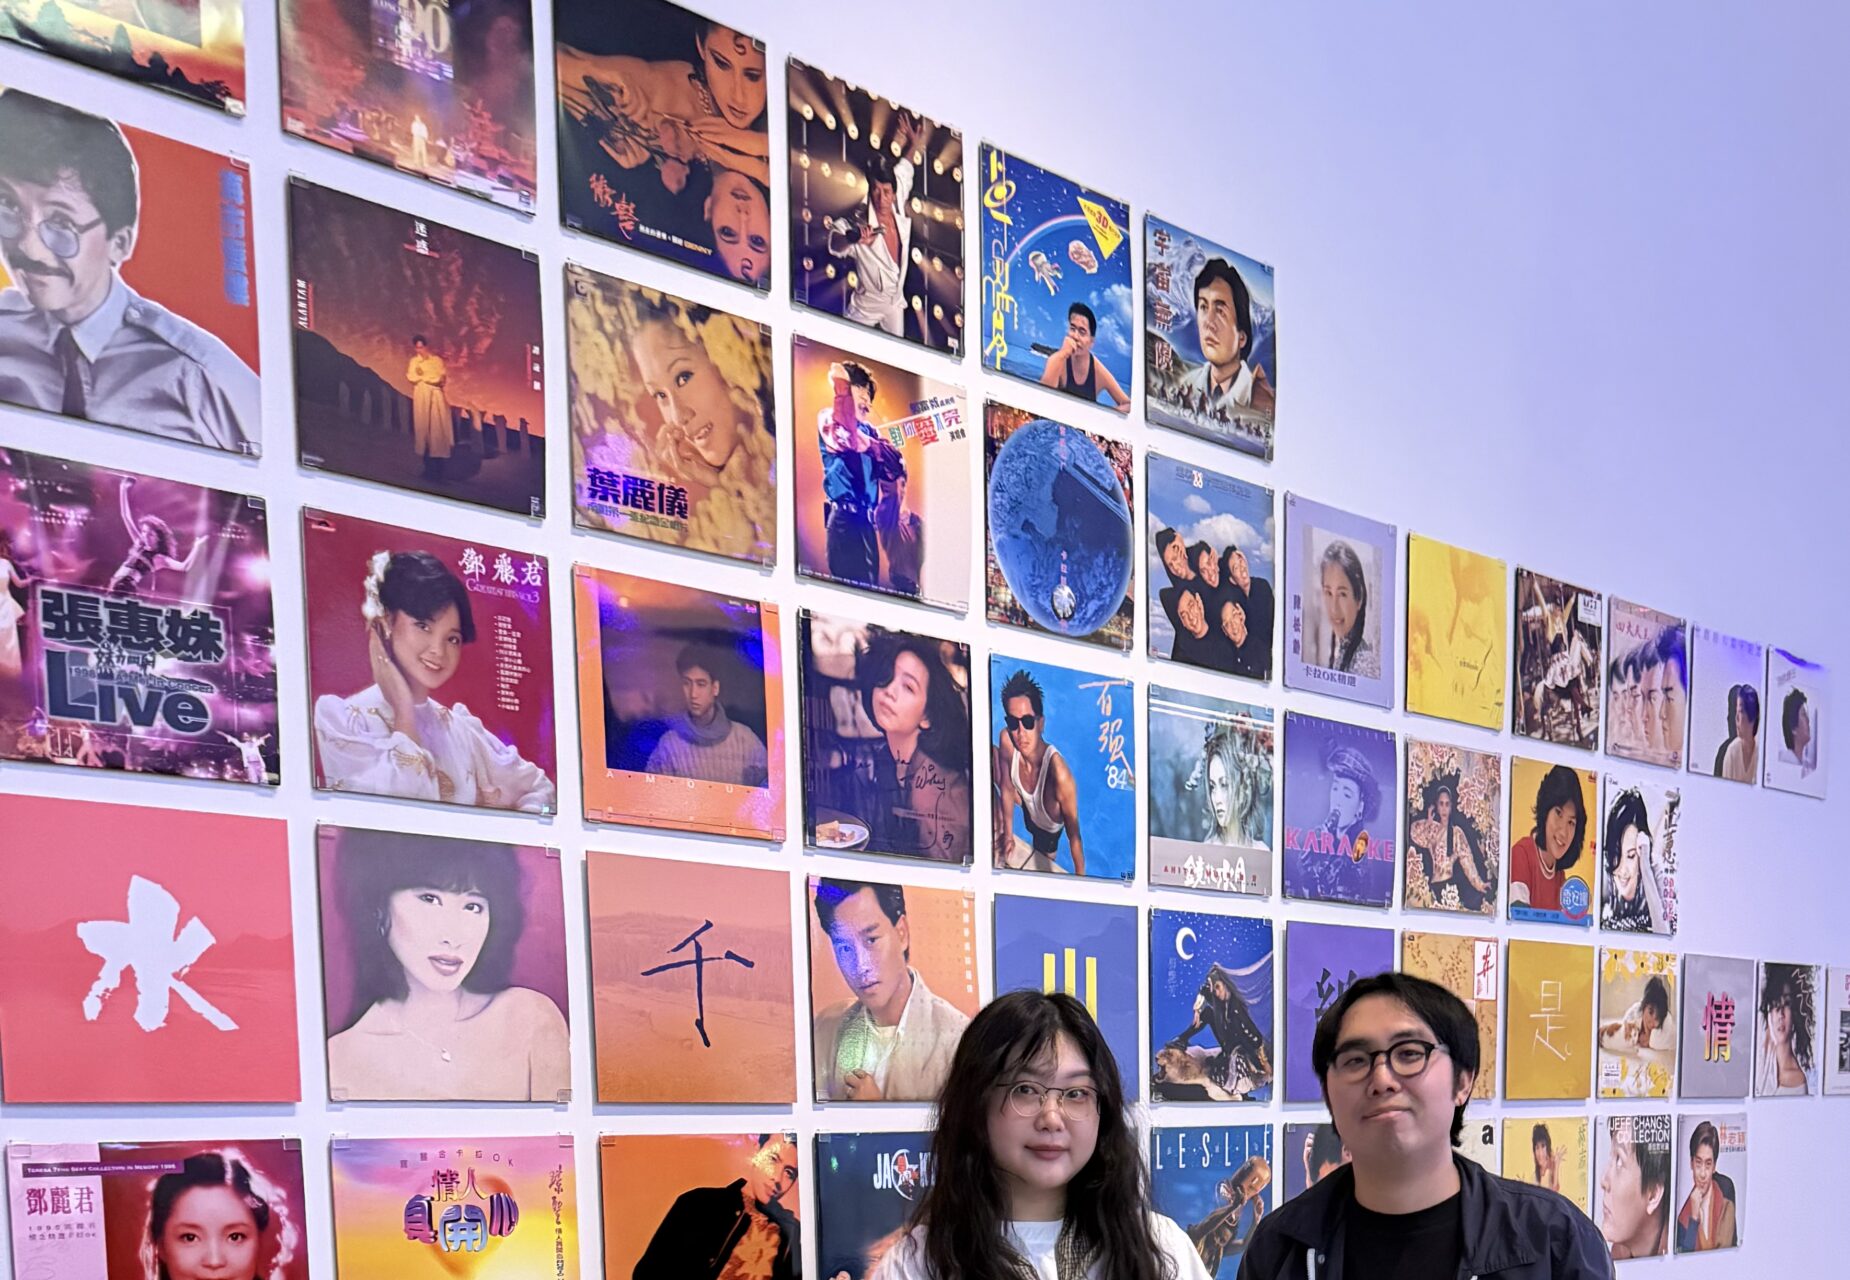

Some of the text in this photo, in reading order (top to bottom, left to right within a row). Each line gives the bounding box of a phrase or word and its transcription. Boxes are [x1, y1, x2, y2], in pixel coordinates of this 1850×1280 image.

[40, 588, 227, 665] 張惠妹
[45, 650, 213, 734] Live
[1284, 825, 1395, 864] KARAOKE
[76, 874, 239, 1031] 水
[641, 918, 755, 1048] 千
[1530, 979, 1573, 1062] 是
[1702, 991, 1736, 1063] 情
[1156, 1126, 1271, 1169] LESLIE
[1616, 1129, 1671, 1144] COLLECTION
[26, 1185, 94, 1215] 鄧麗君
